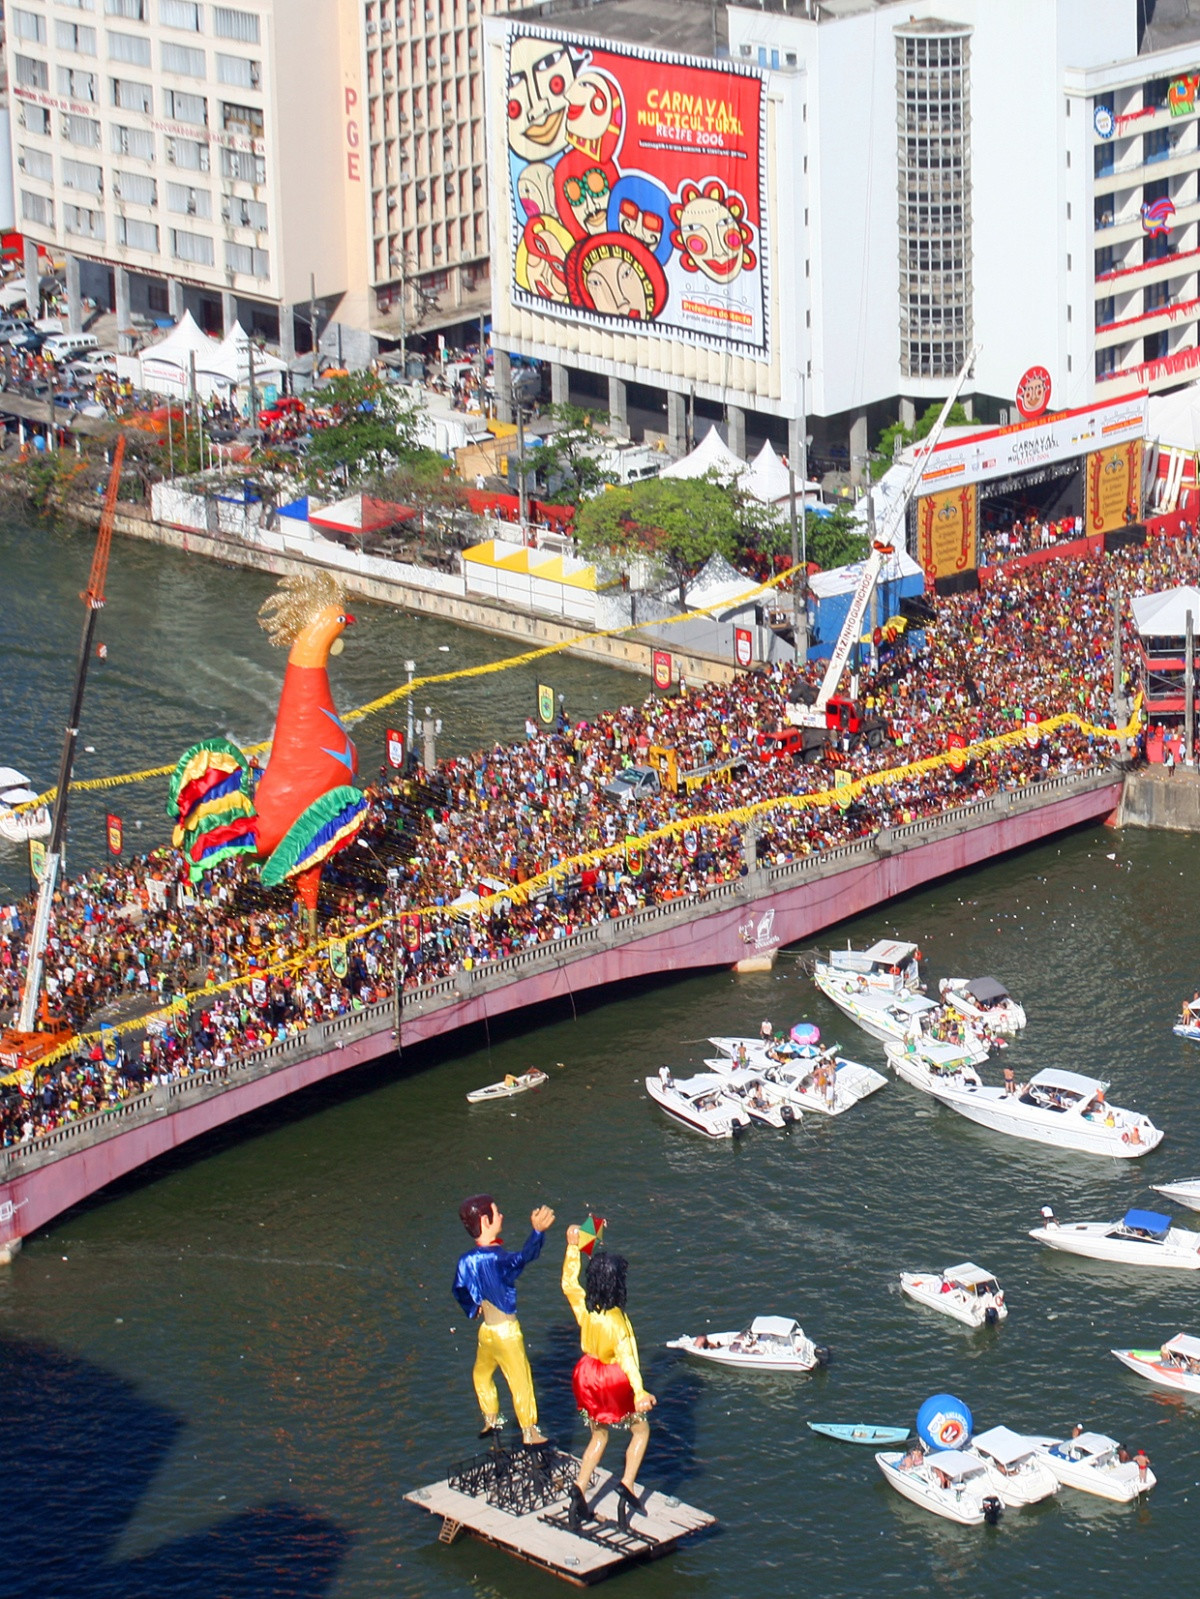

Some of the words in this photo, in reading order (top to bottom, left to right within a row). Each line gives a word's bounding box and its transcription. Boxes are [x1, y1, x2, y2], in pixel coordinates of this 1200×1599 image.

[646, 89, 734, 120] CARNAVAL
[345, 87, 360, 182] PGE
[637, 110, 744, 136] MULTICULTURAL
[656, 123, 693, 143] RECIFE
[696, 131, 725, 147] 2006
[1008, 440, 1059, 463] MULTICULTURAL
[1012, 433, 1056, 453] CARNAVAL
